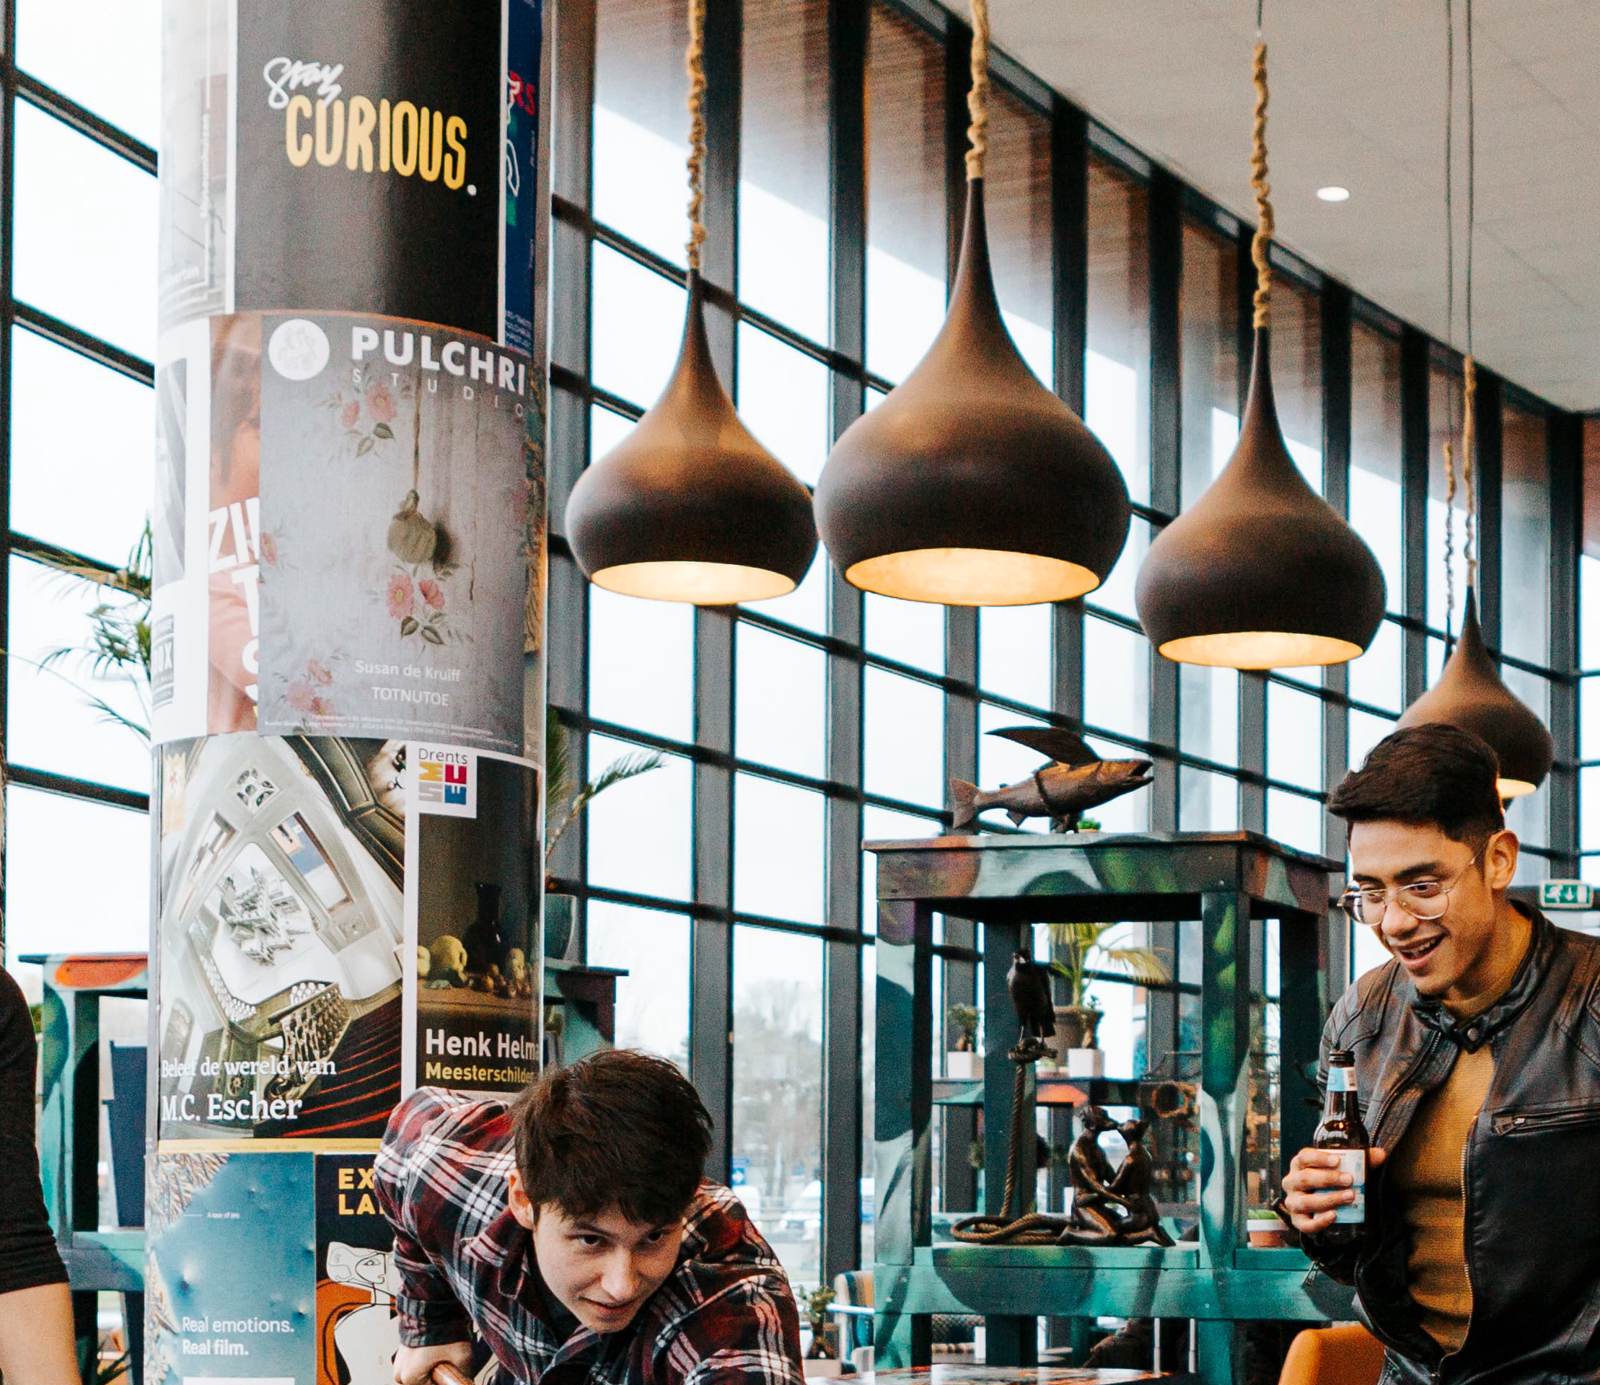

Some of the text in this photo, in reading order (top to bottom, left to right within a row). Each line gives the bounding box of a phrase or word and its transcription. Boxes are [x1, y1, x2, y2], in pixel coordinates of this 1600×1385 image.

[351, 325, 526, 396] PULCHRI
[355, 659, 400, 675] Susan
[402, 664, 422, 678] de
[371, 686, 449, 707] TOTNUTOE
[418, 747, 468, 765] Drents
[425, 1028, 492, 1057] Henk
[200, 1056, 220, 1076] de
[223, 1054, 290, 1077] wereld
[295, 1060, 338, 1076] van
[162, 1090, 304, 1122] M.C. Escher
[182, 1316, 296, 1334] Real emotions.
[182, 1338, 250, 1356] Real film.
